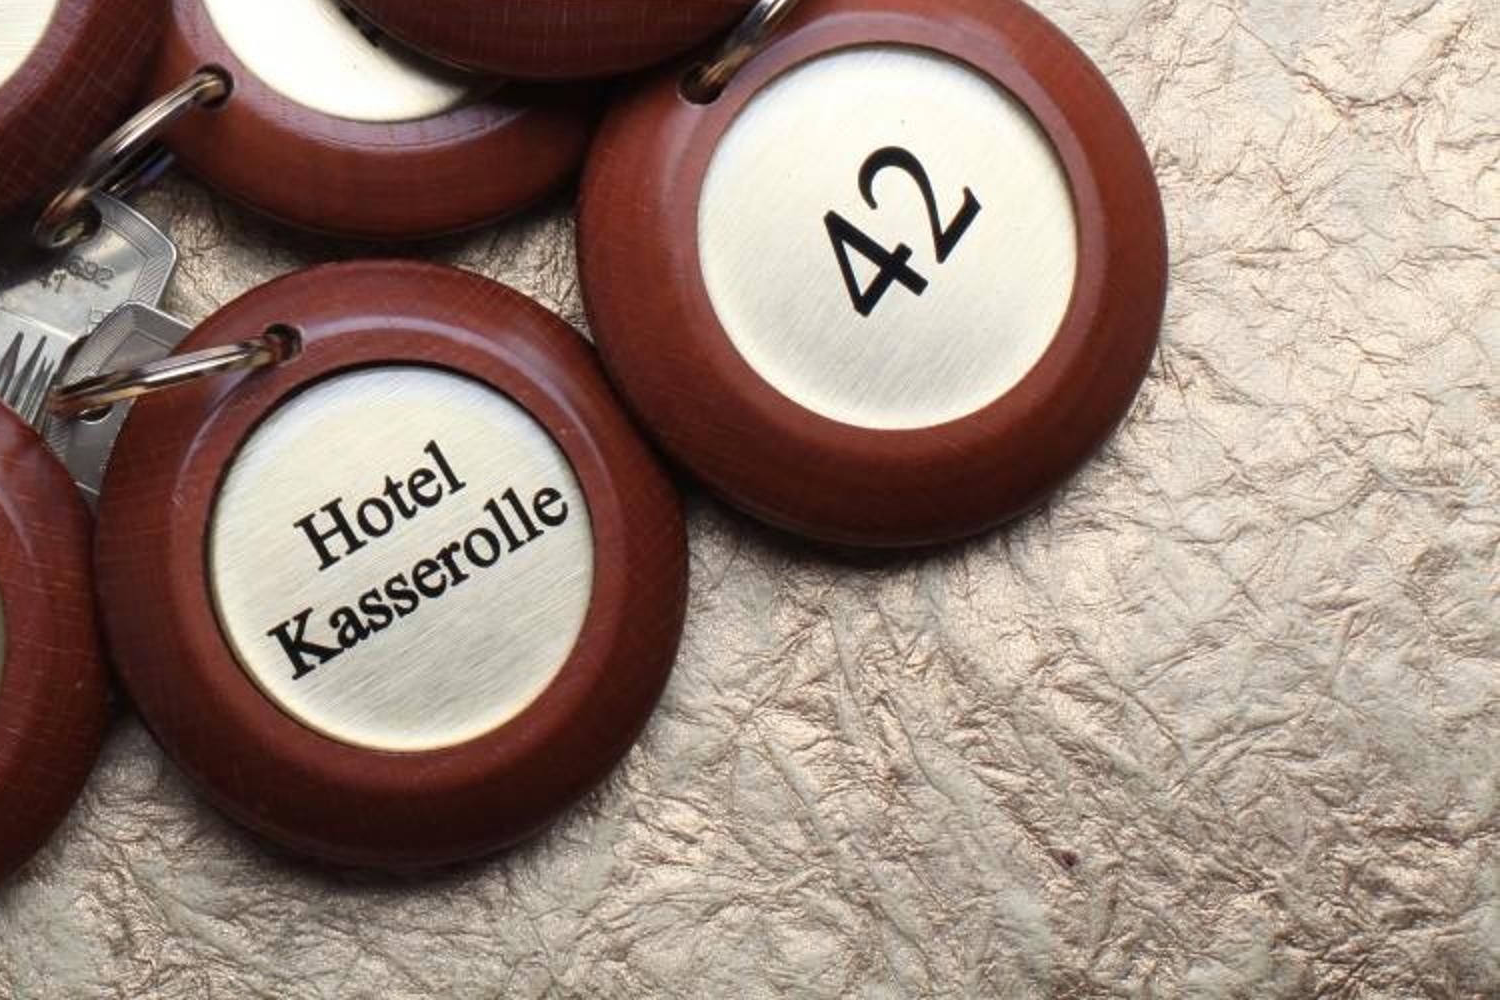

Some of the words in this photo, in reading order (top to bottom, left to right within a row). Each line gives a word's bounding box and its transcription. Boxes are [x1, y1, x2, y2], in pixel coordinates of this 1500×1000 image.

[823, 146, 983, 318] 42
[265, 485, 570, 682] Kasserolle
[292, 439, 468, 573] Hotel
